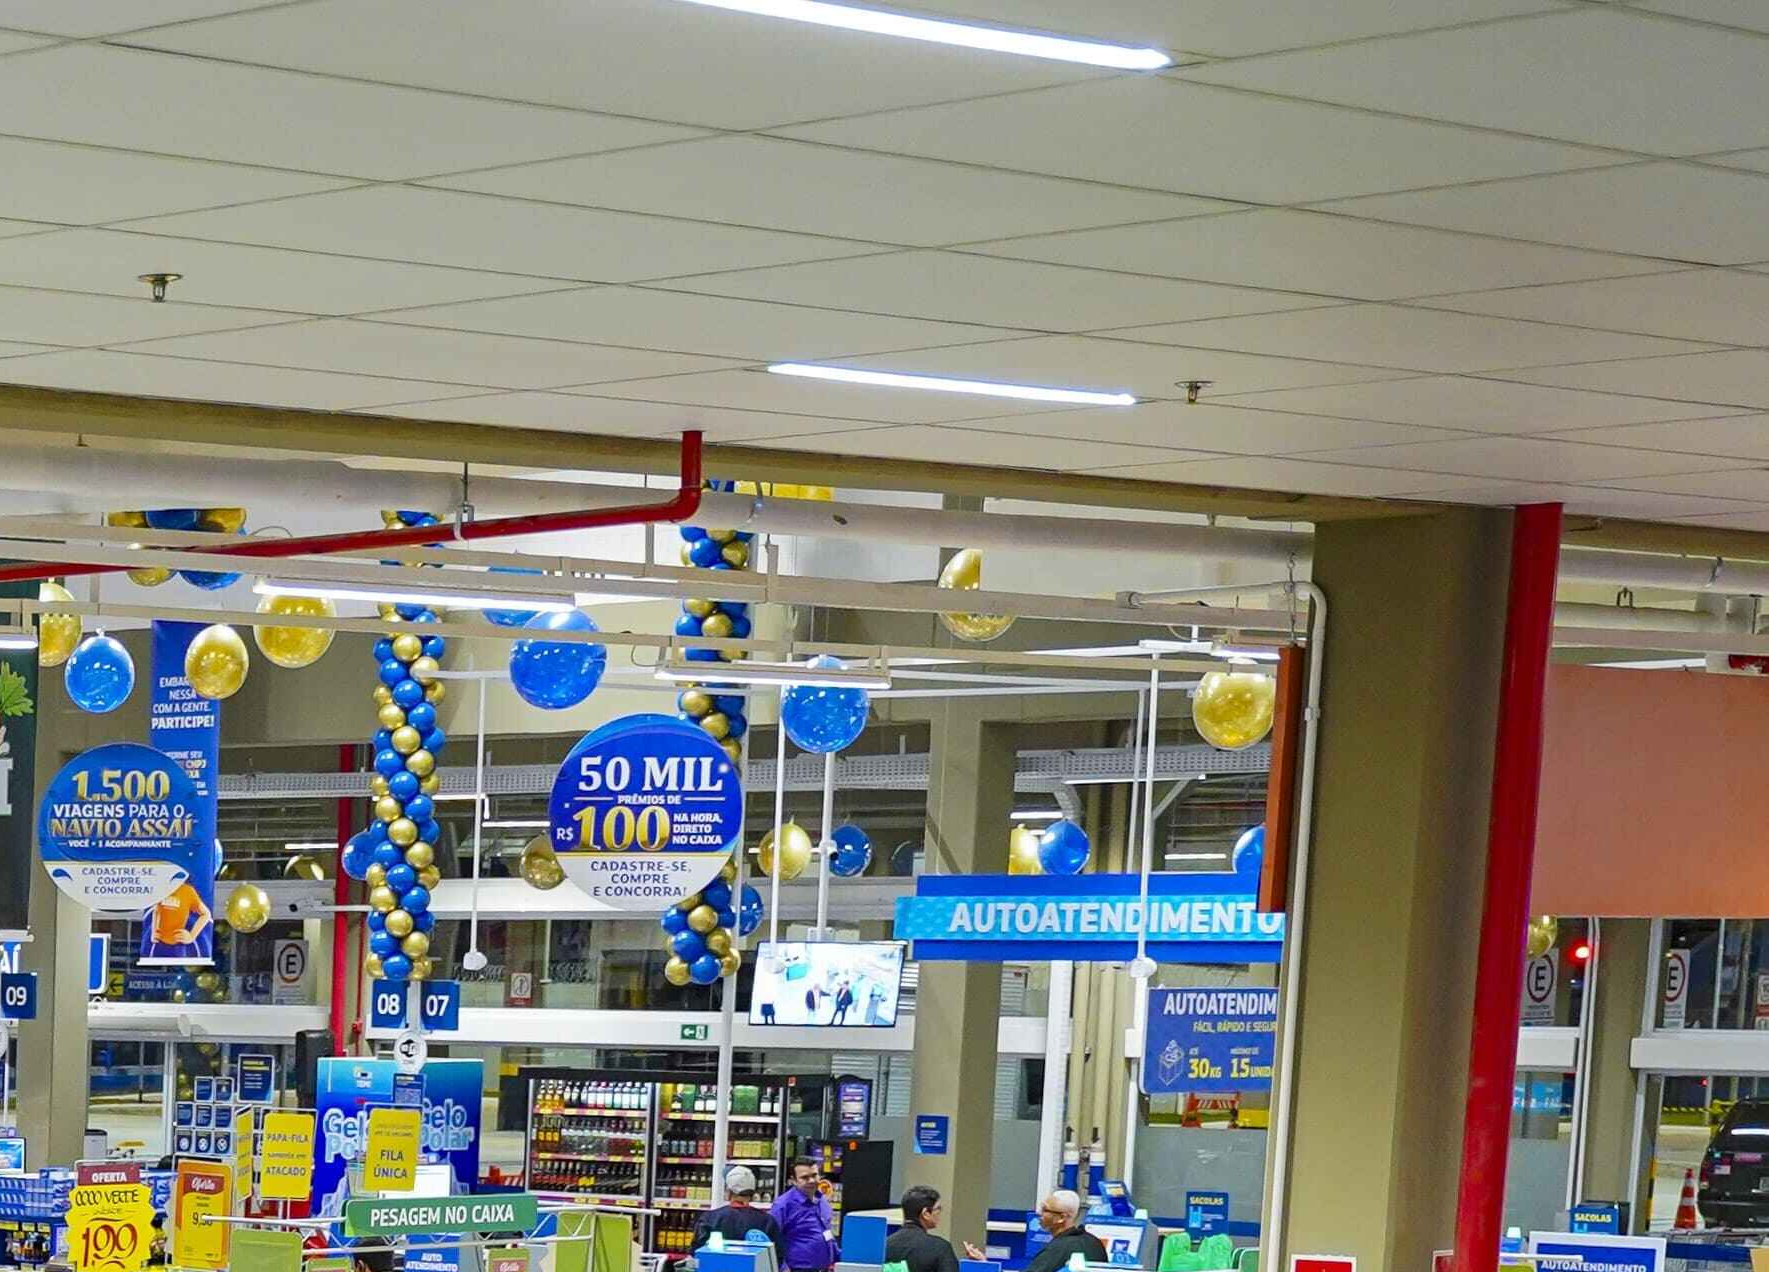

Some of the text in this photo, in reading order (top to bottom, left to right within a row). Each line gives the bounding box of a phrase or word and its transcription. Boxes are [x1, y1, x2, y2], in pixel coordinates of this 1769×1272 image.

[152, 716, 214, 728] PARTICIPE!
[579, 756, 722, 791] 50 MIL
[72, 770, 169, 801] 1.500
[618, 794, 681, 804] PRÊMIOS DE
[53, 805, 184, 817] VIAGENS PARA O
[52, 819, 123, 837] NAVIO
[557, 806, 669, 851] R$ 100
[673, 825, 711, 833] DIRETO
[672, 836, 721, 844] NO CAIXA
[98, 877, 140, 885] COMPRE
[611, 874, 668, 883] COMPRE
[594, 886, 686, 896] E CONCORRA!
[949, 902, 1284, 933] AUTOATENDIMENTO
[286, 954, 296, 974] E
[6, 986, 25, 1005] 09
[378, 994, 399, 1014] 08
[426, 995, 449, 1016] 07
[380, 1150, 404, 1161] FILA
[265, 1167, 306, 1176] ATACADO
[371, 1203, 514, 1227] PESAGEM NO CAIXA
[422, 1252, 442, 1262] AUTO
